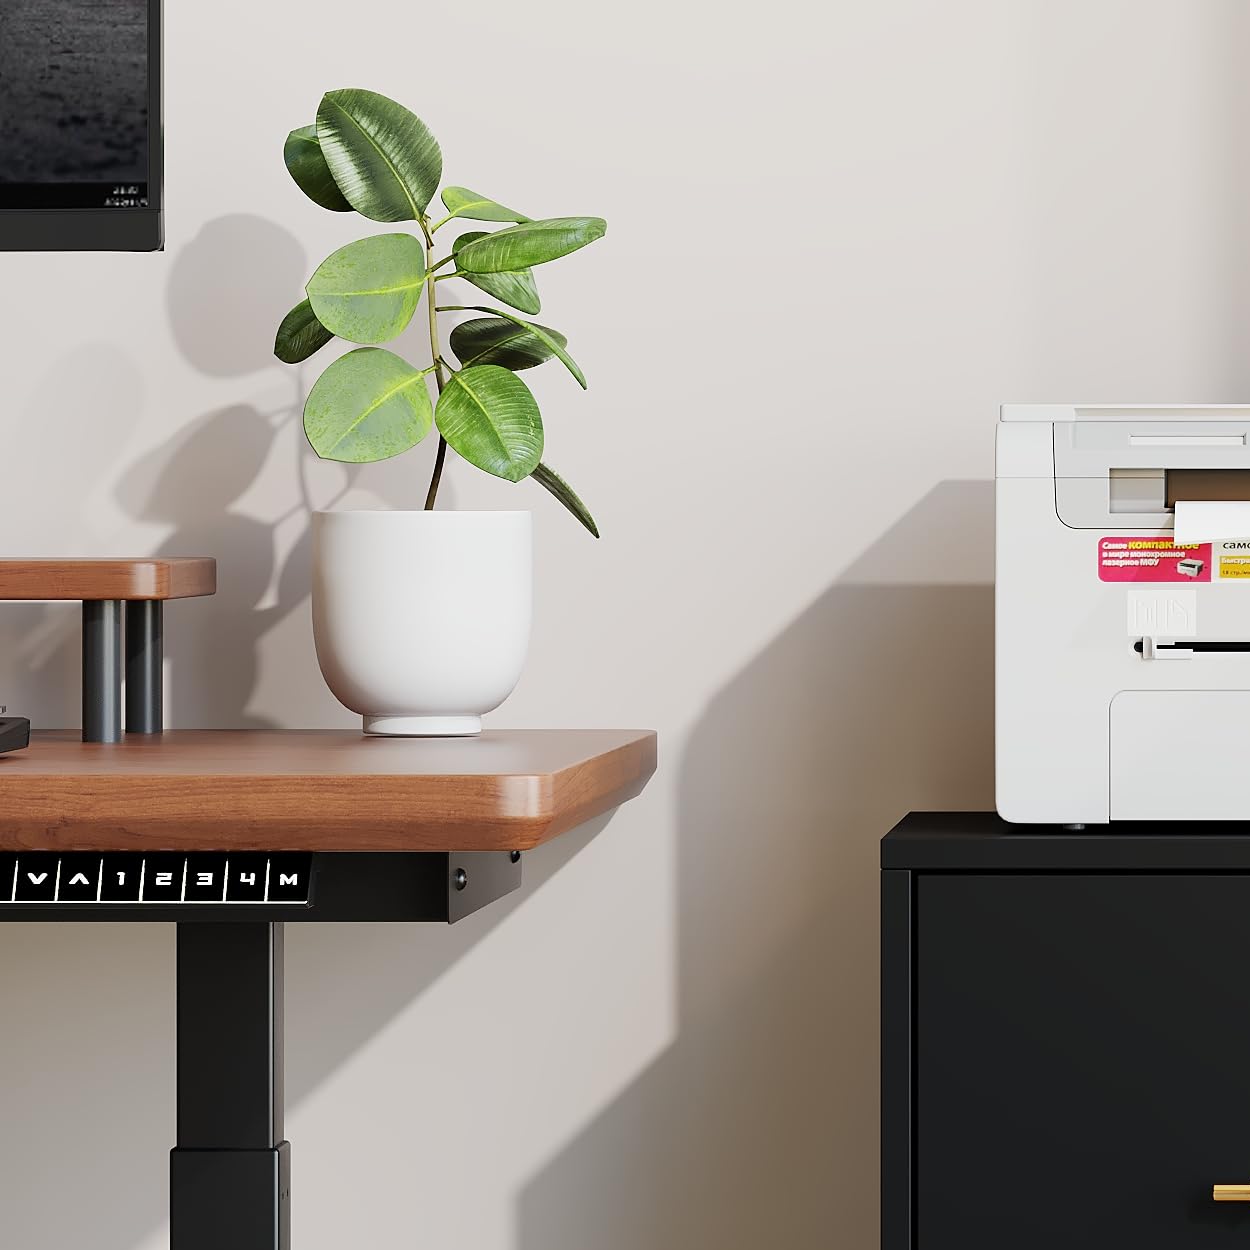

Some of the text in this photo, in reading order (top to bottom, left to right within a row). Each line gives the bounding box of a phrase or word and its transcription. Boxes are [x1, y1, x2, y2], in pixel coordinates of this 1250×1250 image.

[1102, 542, 1128, 550] Самое
[1102, 559, 1139, 567] лазерное
[117, 871, 298, 885] 1 2 3 4 M
